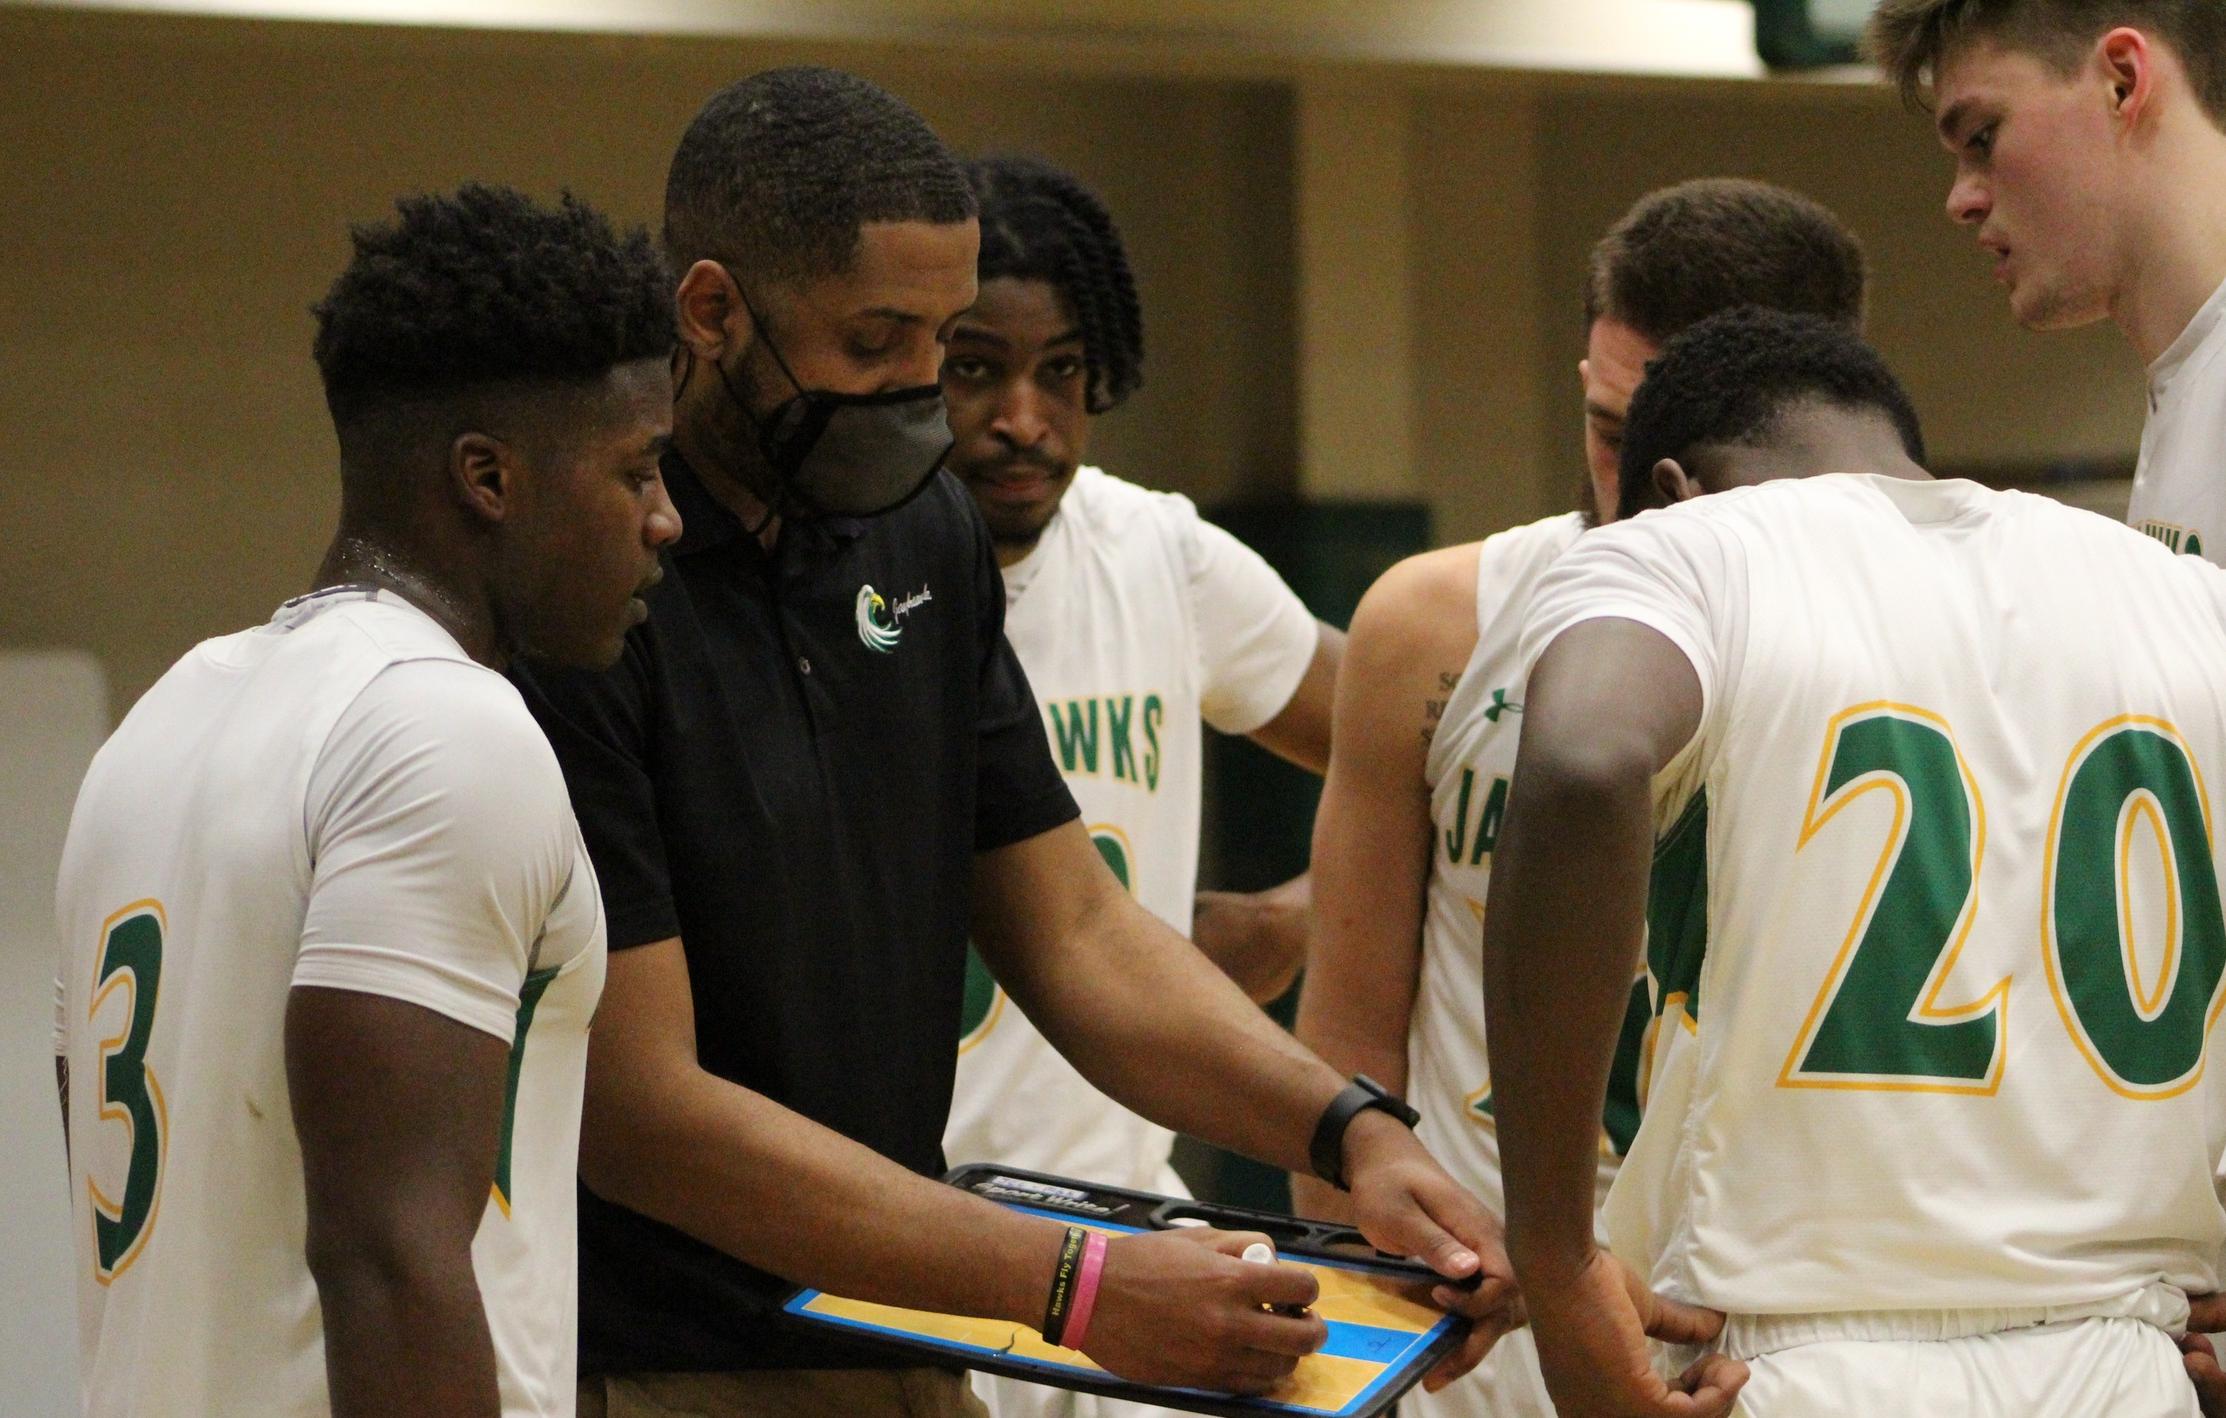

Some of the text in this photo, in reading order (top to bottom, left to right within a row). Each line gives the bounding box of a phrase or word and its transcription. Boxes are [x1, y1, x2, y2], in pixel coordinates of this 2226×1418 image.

[1048, 692, 1163, 793] WKS
[1444, 765, 1511, 868] JA
[1774, 699, 2226, 1101] 20
[87, 897, 169, 1288] 3
[1051, 1280, 1067, 1316] Hawks
[1059, 1262, 1072, 1279] Fly
